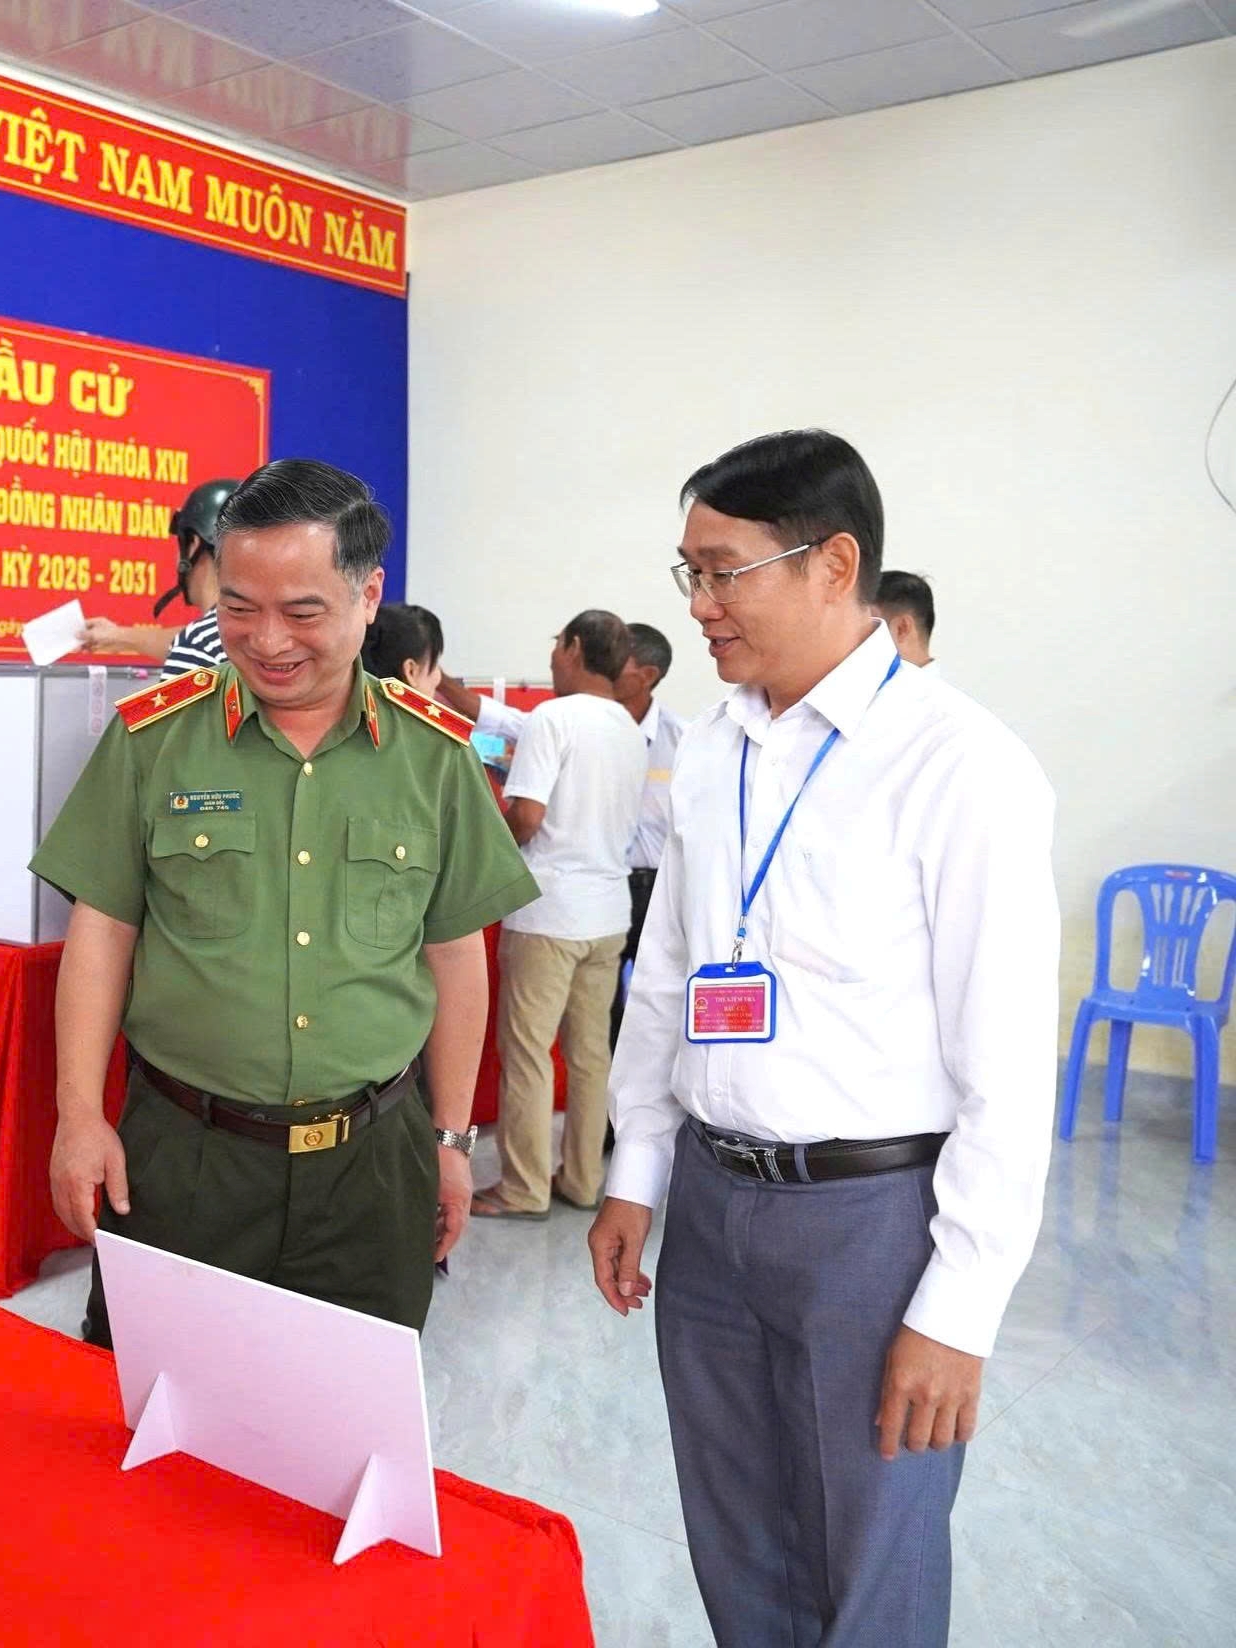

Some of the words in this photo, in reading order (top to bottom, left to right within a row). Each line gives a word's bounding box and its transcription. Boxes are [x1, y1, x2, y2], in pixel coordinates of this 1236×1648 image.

[97, 141, 194, 215] NAM
[205, 174, 313, 248] MUÔN
[323, 209, 397, 272] NĂM
[68, 364, 135, 418] CỬ
[53, 428, 93, 479] HỘI
[95, 437, 152, 480] KHÓA
[154, 448, 189, 485] XVI
[59, 491, 125, 536] NHÂN
[127, 498, 171, 540] DÂN
[0, 543, 34, 589] KỲ
[37, 553, 92, 593] 2026
[108, 559, 157, 597] 2031
